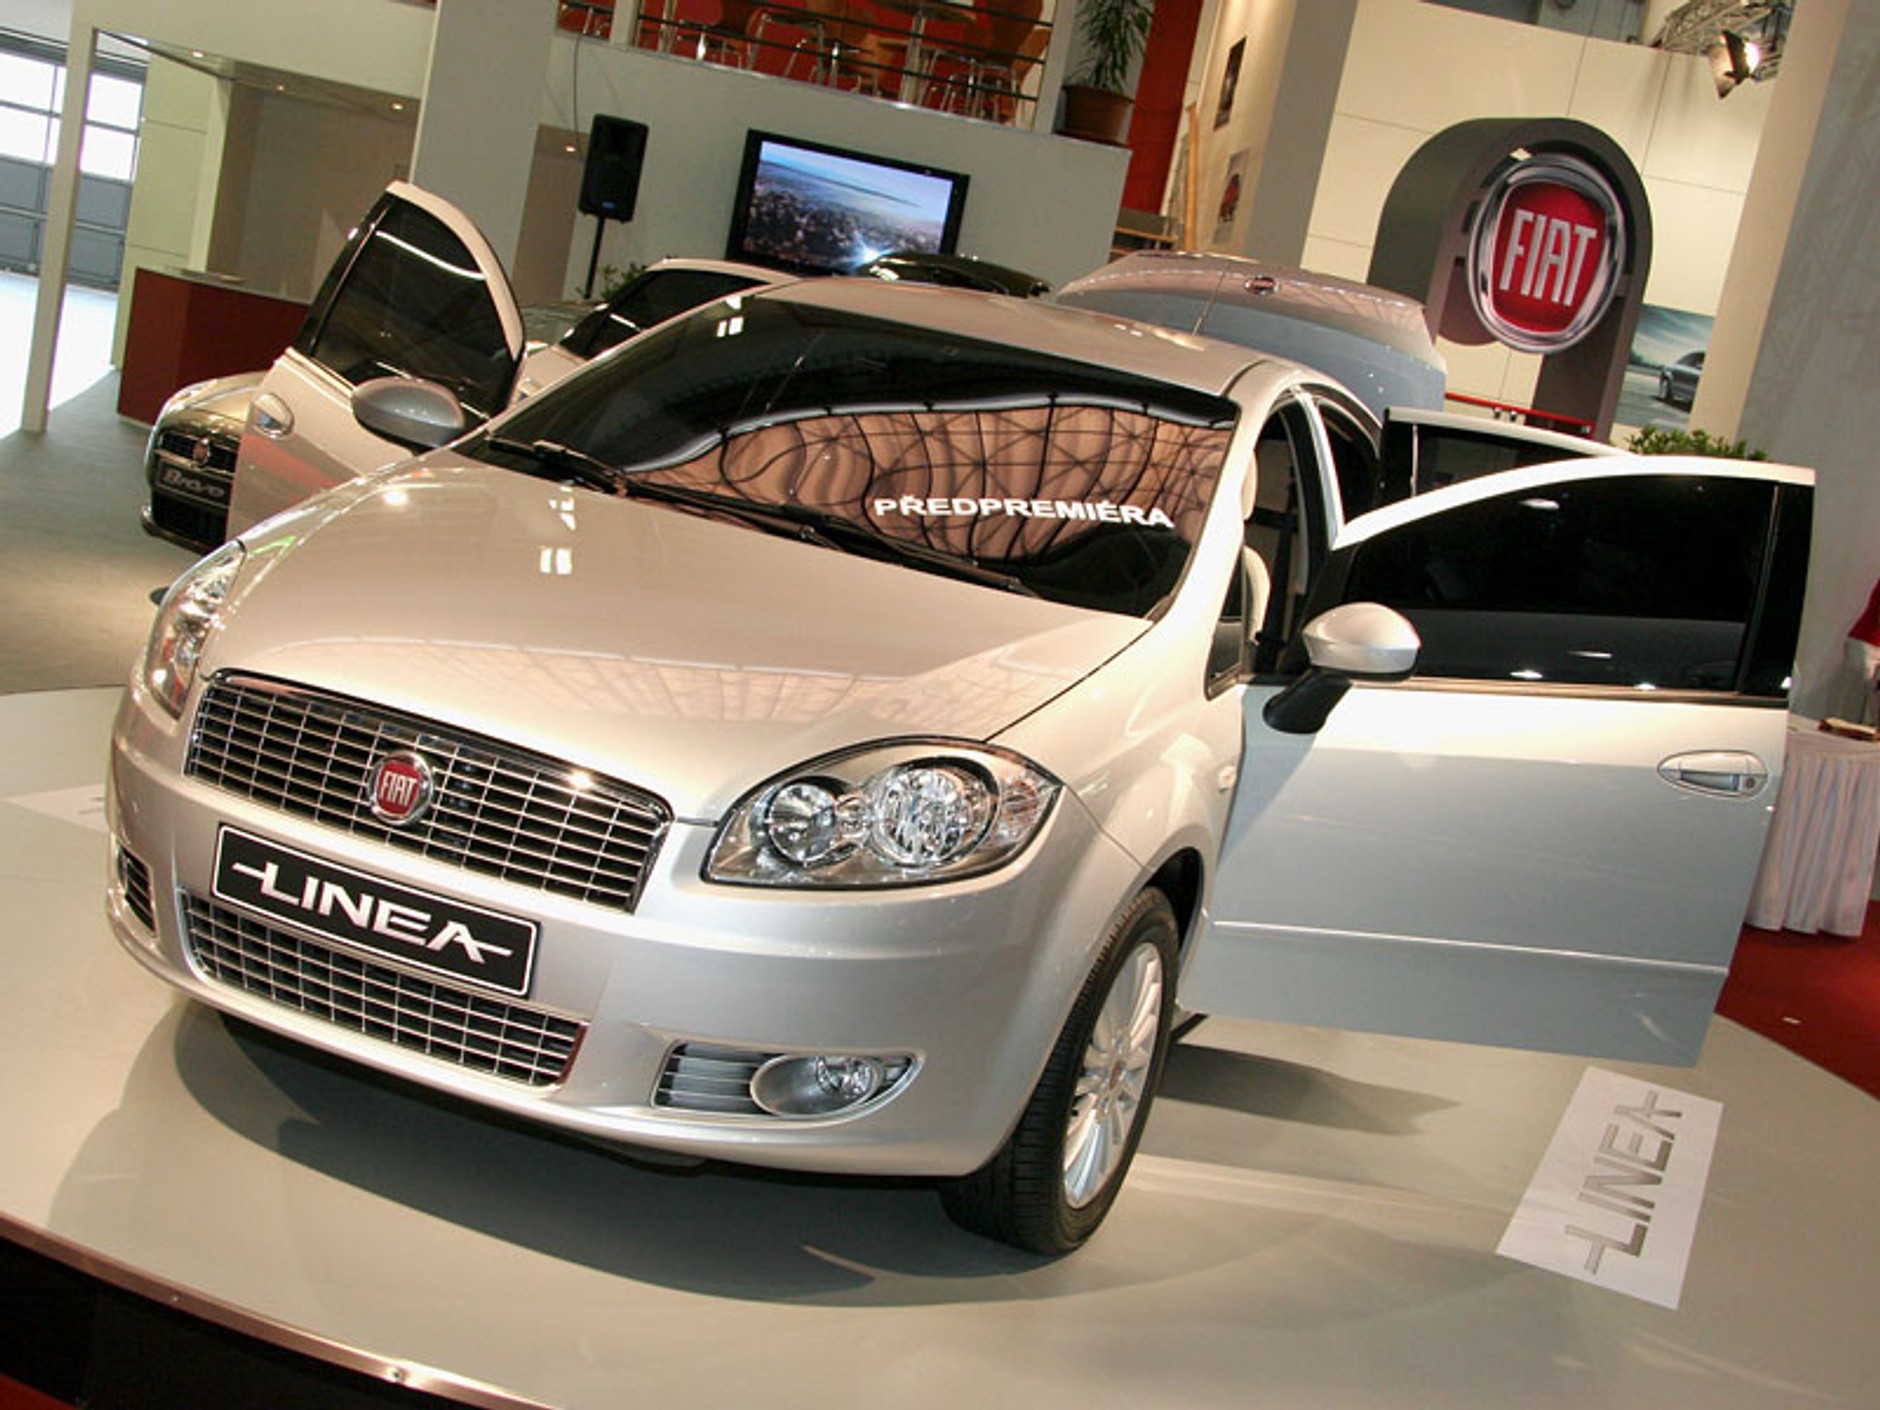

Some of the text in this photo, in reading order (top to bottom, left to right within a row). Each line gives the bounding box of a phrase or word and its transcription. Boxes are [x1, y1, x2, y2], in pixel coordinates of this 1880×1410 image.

[1499, 208, 1598, 308] FIAT
[873, 495, 1175, 529] PŘEDPREMIÉRA
[380, 770, 418, 807] FIAT
[232, 860, 514, 965] LINEA
[1564, 1090, 1683, 1276] LINEA
